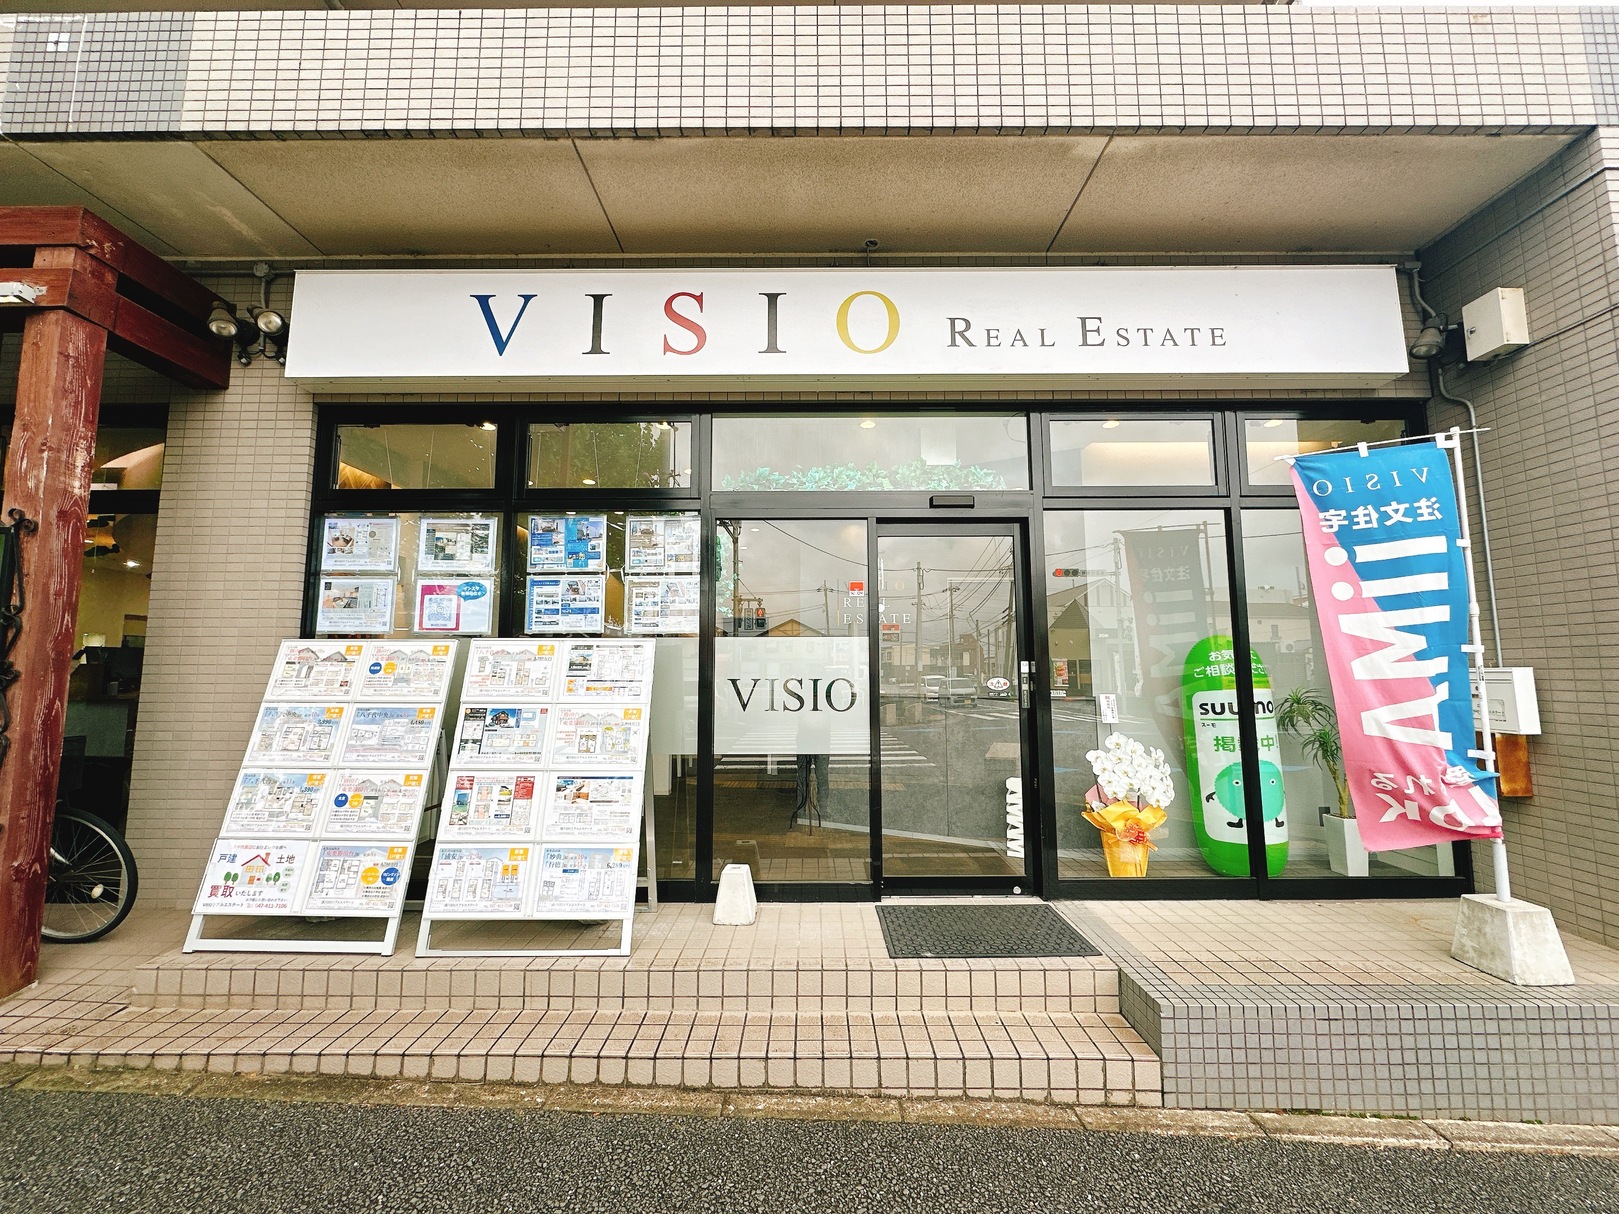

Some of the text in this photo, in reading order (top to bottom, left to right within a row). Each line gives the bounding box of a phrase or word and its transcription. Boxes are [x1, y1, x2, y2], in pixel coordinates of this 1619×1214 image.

[470, 290, 900, 357] VISIO
[843, 597, 890, 608] REL
[843, 613, 911, 624] ESATE
[727, 677, 858, 712] VISIO
[217, 853, 296, 864] 戸建 土地
[208, 885, 235, 898] 買取
